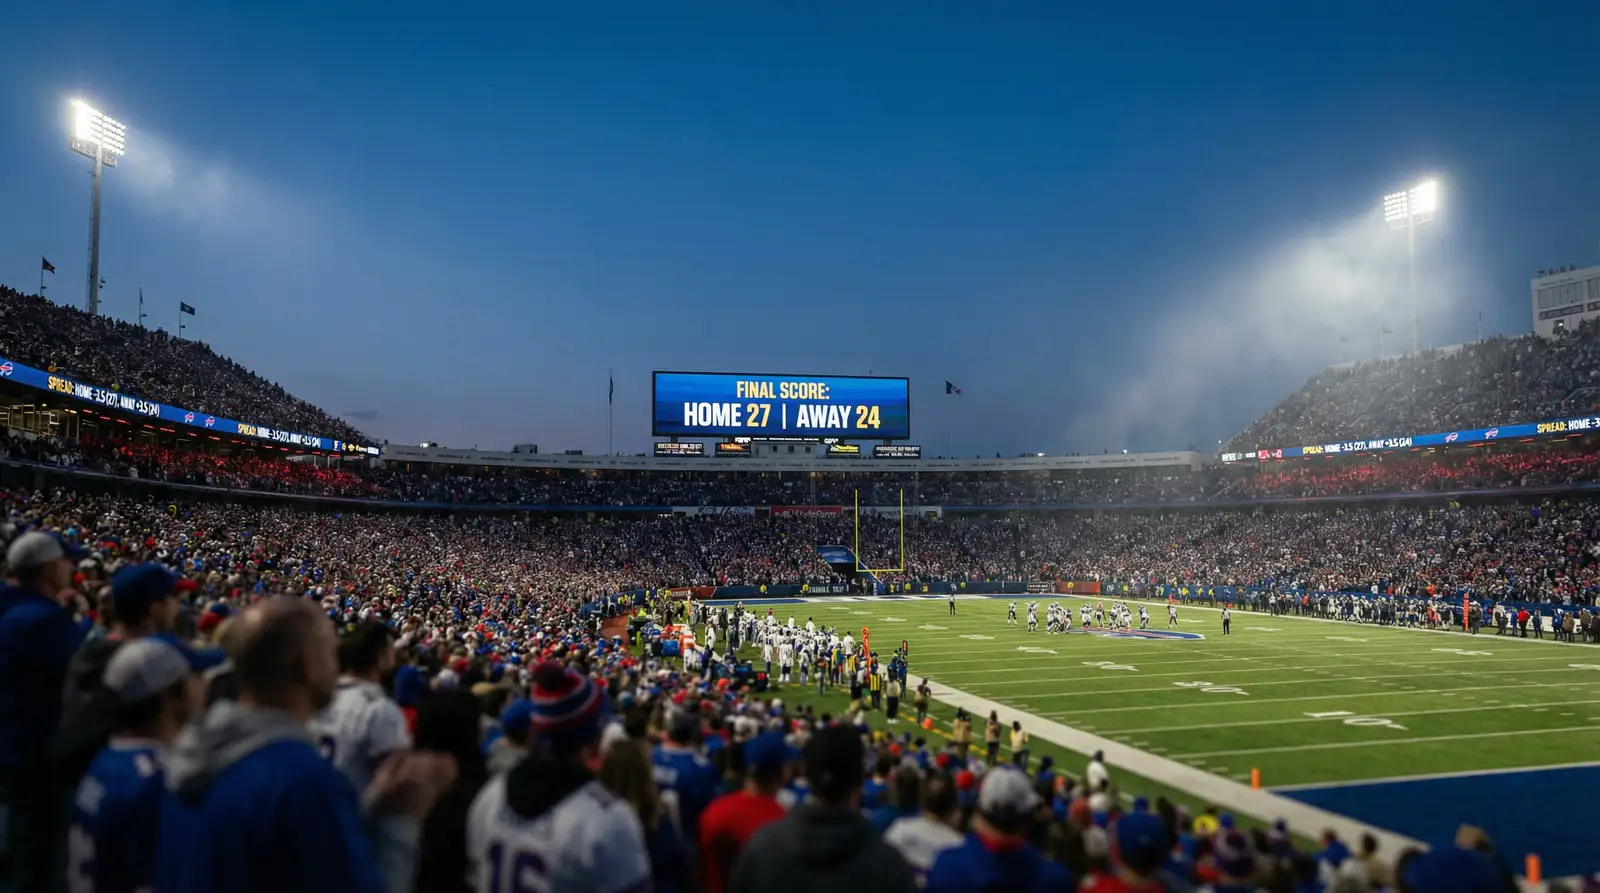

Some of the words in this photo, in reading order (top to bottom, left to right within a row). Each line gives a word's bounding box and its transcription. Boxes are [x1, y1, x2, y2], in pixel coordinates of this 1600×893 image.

[48, 376, 74, 395] SPREAD:
[75, 383, 92, 400] HOME
[736, 381, 776, 399] FINAL
[780, 382, 830, 400] SCORE:
[684, 402, 741, 427] HOME
[746, 403, 771, 427] 27
[796, 404, 851, 429] AWAY
[856, 405, 880, 429] 24
[1537, 421, 1568, 433] SPREAD:
[1568, 418, 1591, 430] HOME
